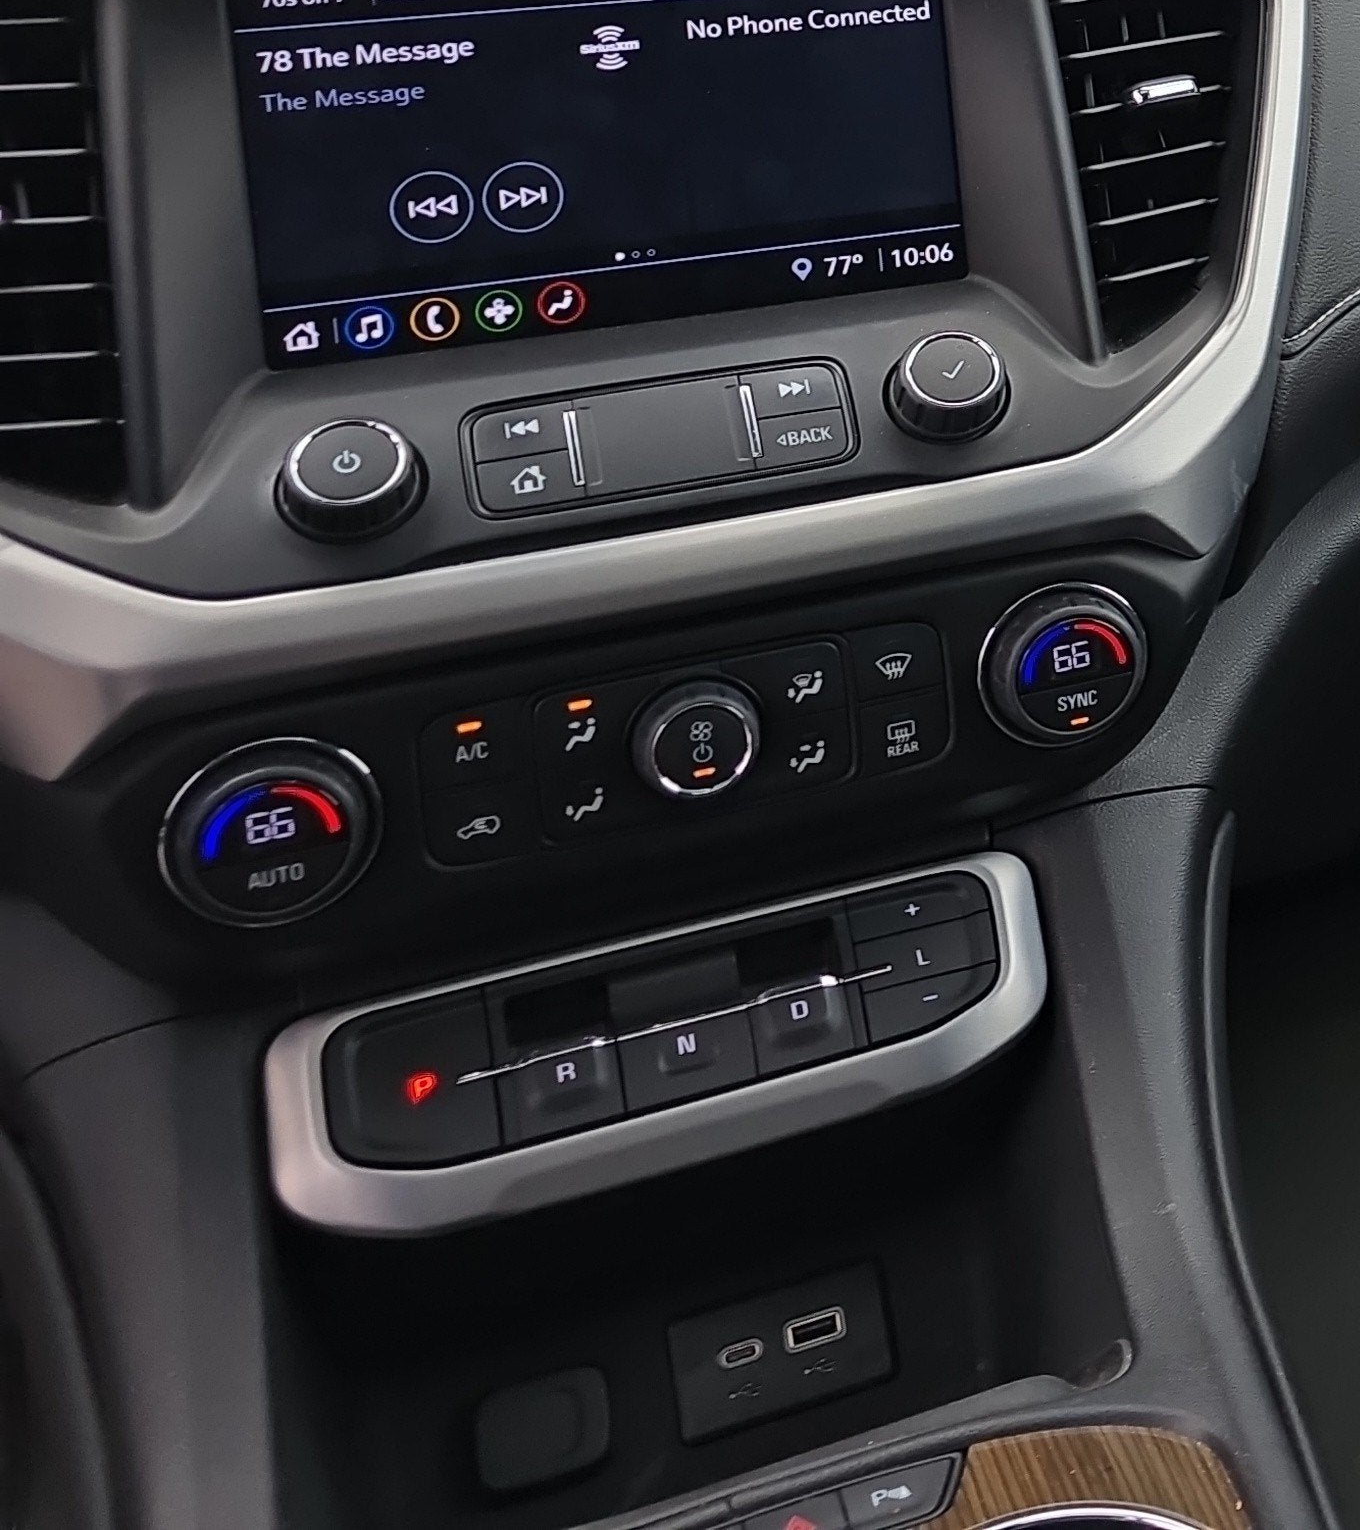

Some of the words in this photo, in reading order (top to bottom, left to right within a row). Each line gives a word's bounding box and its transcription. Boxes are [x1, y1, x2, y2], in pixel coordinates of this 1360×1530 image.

[686, 19, 723, 40] No
[727, 13, 803, 37] Phone
[807, 0, 931, 30] Connected
[256, 50, 293, 73] 78
[296, 46, 350, 70] The
[355, 40, 475, 65] Message
[259, 92, 308, 113] The
[314, 86, 425, 108] Message
[891, 242, 954, 268] 10:06
[786, 425, 833, 446] BACK
[1053, 640, 1091, 673] 66
[1057, 689, 1098, 712] SYNC
[455, 741, 490, 763] A/C
[887, 741, 919, 758] REAR
[245, 806, 296, 845] 66
[248, 862, 305, 890] AUTO
[915, 949, 931, 966] L
[790, 1000, 809, 1020] D
[675, 1032, 697, 1055] N
[556, 1062, 577, 1083] R
[410, 1074, 436, 1103] P
